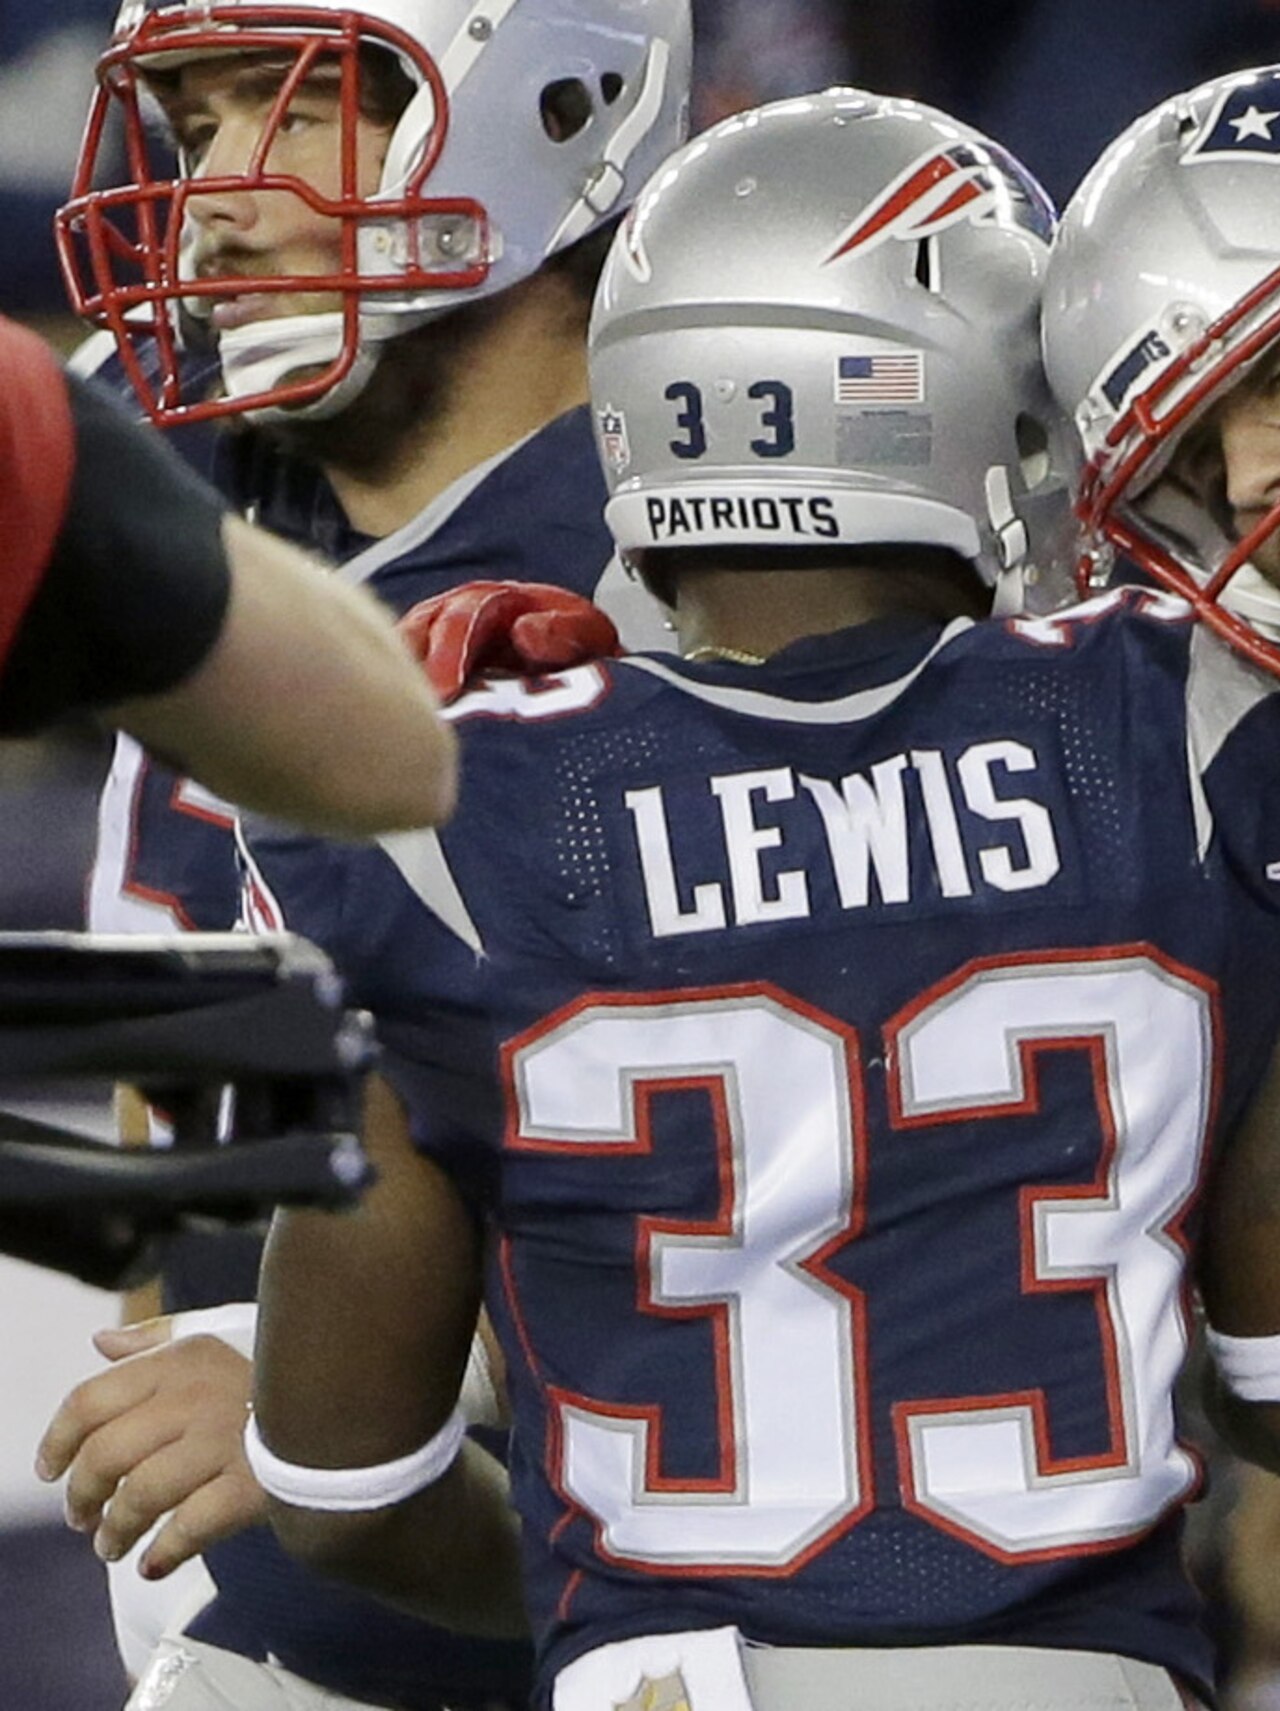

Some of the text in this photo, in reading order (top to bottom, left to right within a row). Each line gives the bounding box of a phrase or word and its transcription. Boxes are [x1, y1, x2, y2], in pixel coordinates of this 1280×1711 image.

[645, 496, 840, 542] PATRIOTS
[624, 739, 1060, 938] LEWIS
[500, 941, 1225, 1577] 33
